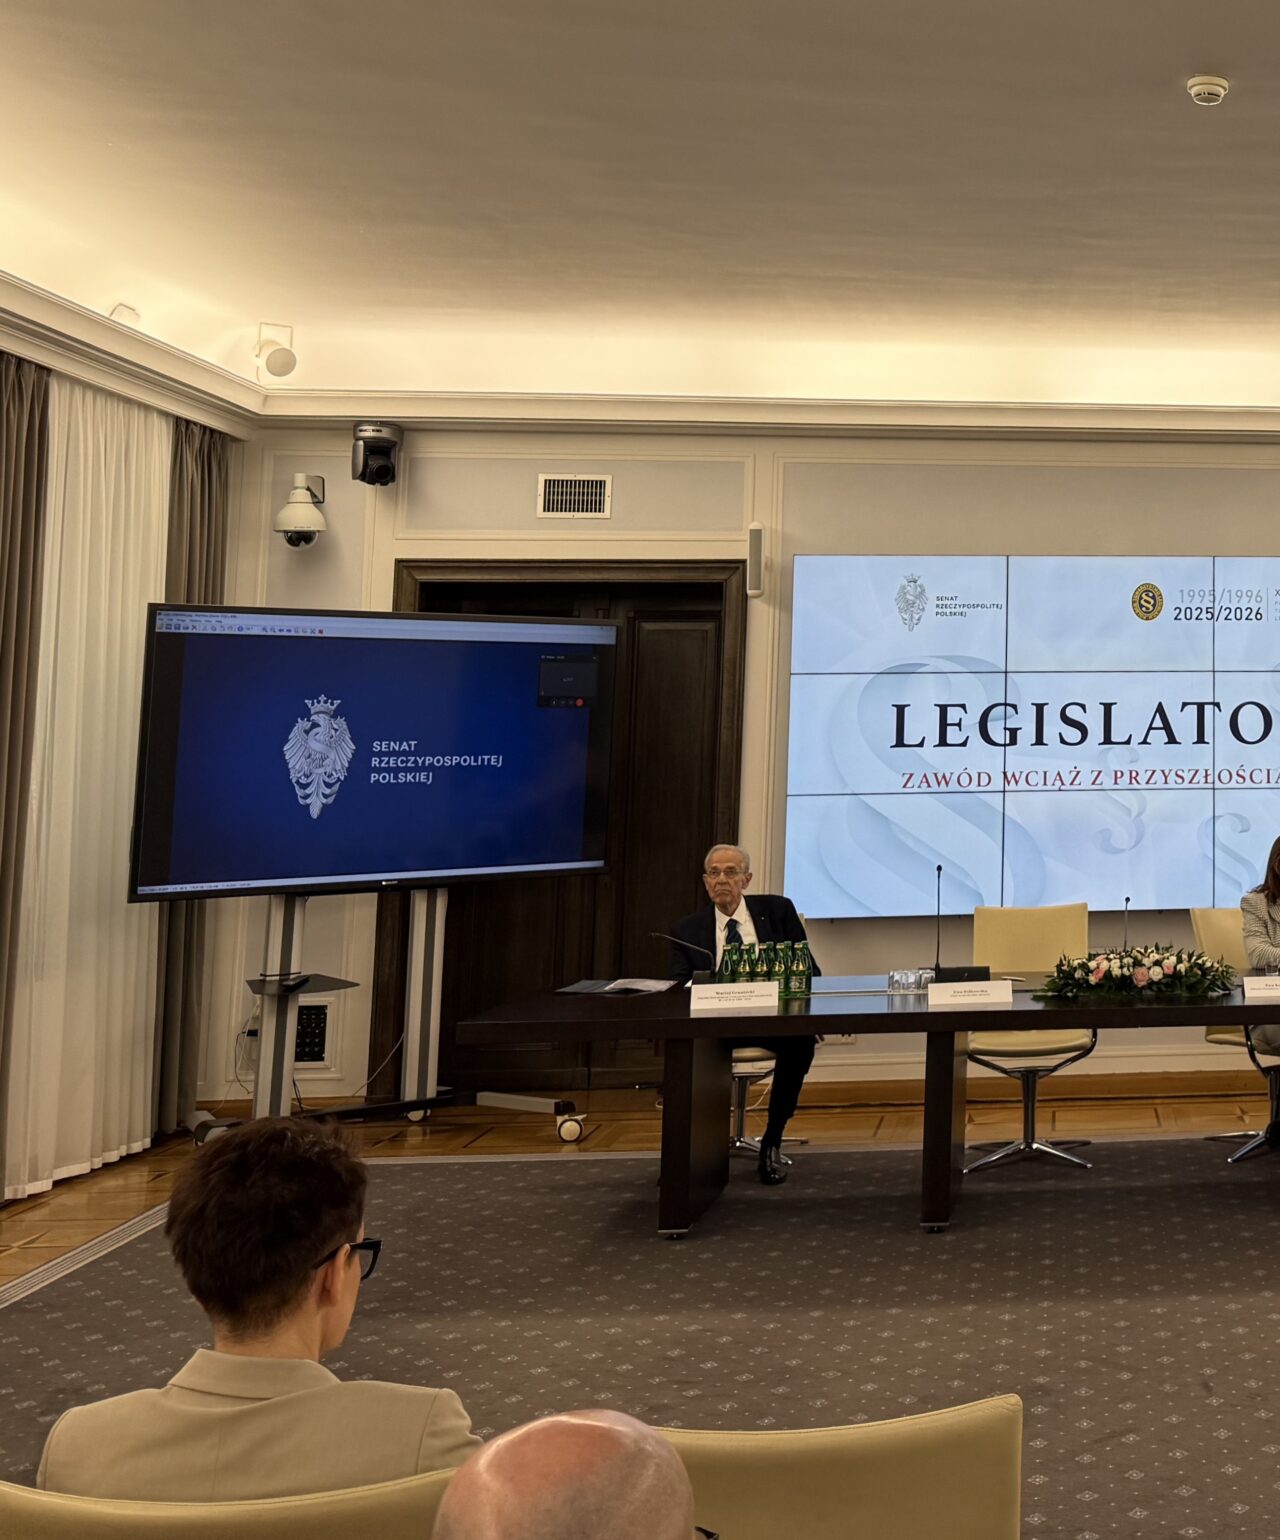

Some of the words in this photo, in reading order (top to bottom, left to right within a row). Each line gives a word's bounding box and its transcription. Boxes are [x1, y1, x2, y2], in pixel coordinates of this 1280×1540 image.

[1179, 587, 1263, 604] 1995/1996
[1173, 605, 1263, 622] 2025/2026
[372, 740, 418, 752] SENAT
[371, 755, 503, 767] RZECZYPOSPOLITEJ
[370, 772, 433, 784] POLSKIEJ
[902, 767, 992, 789] ZAWÓD
[1002, 766, 1081, 791] WCIĄŻ
[1090, 769, 1104, 786] Z
